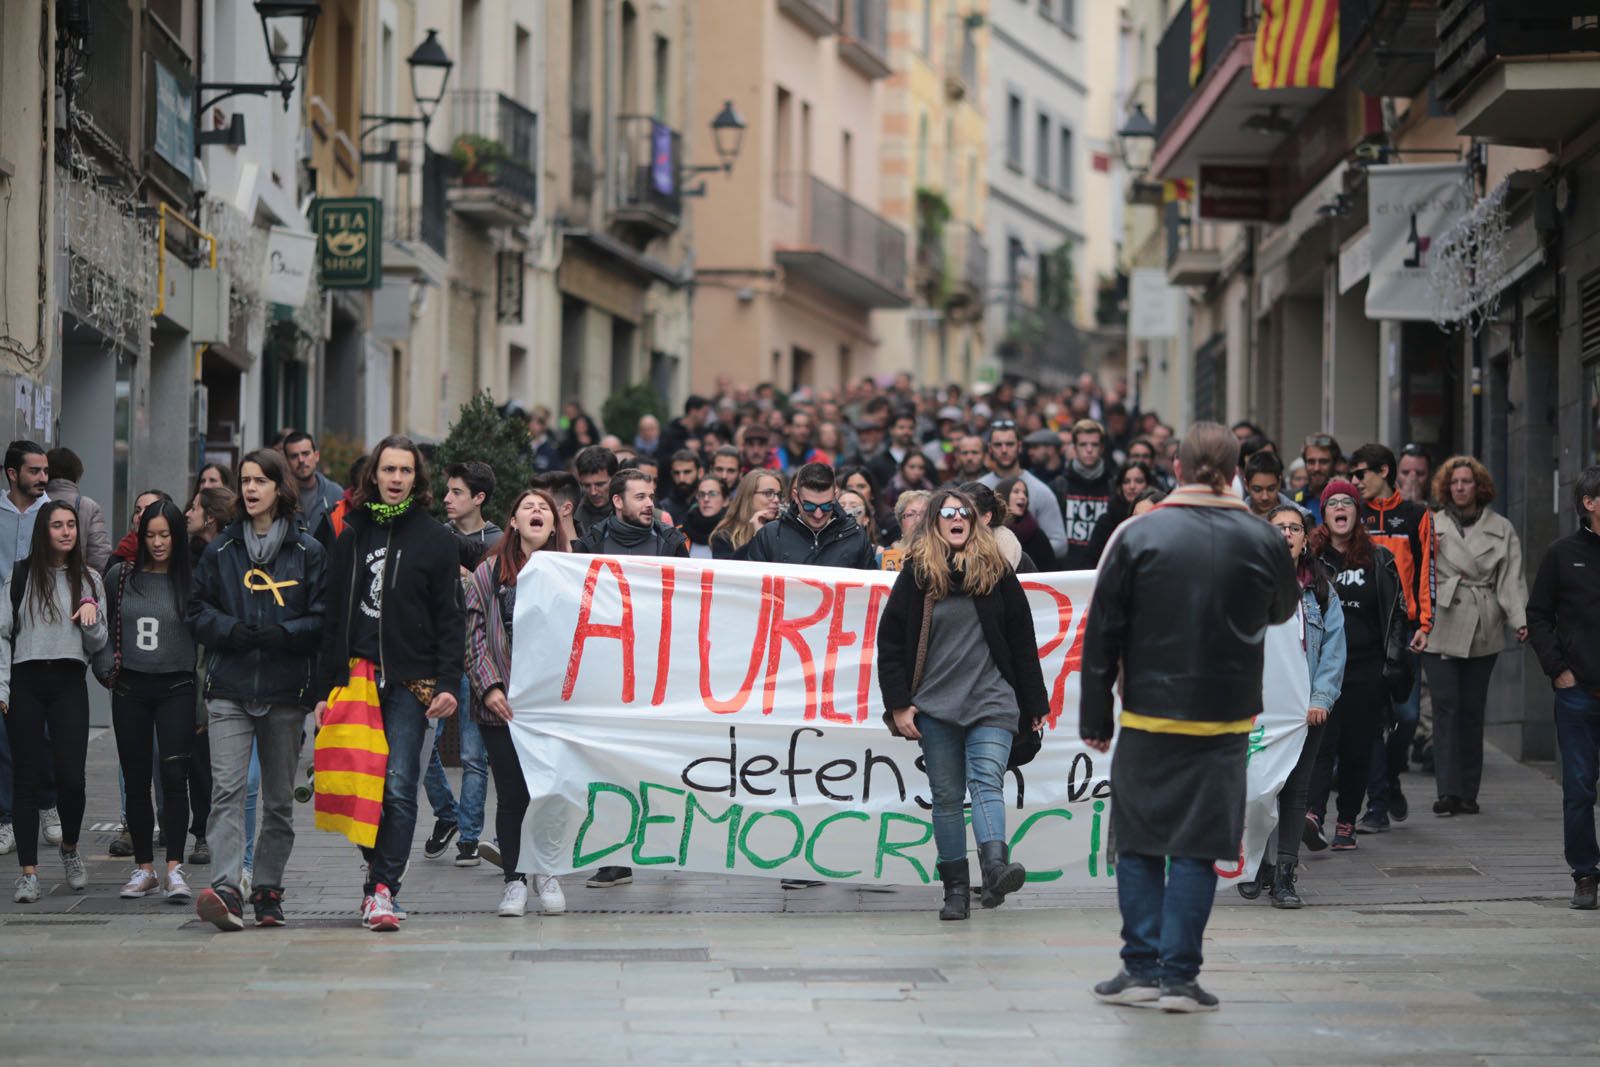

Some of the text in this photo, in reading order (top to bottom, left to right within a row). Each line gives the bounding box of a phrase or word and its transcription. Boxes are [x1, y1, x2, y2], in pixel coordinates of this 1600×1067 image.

[326, 212, 366, 229] TEA
[325, 257, 366, 271] SHOP
[1066, 519, 1096, 541] ISI
[136, 617, 159, 652] 8
[573, 780, 1116, 883] DEMOCRCi
